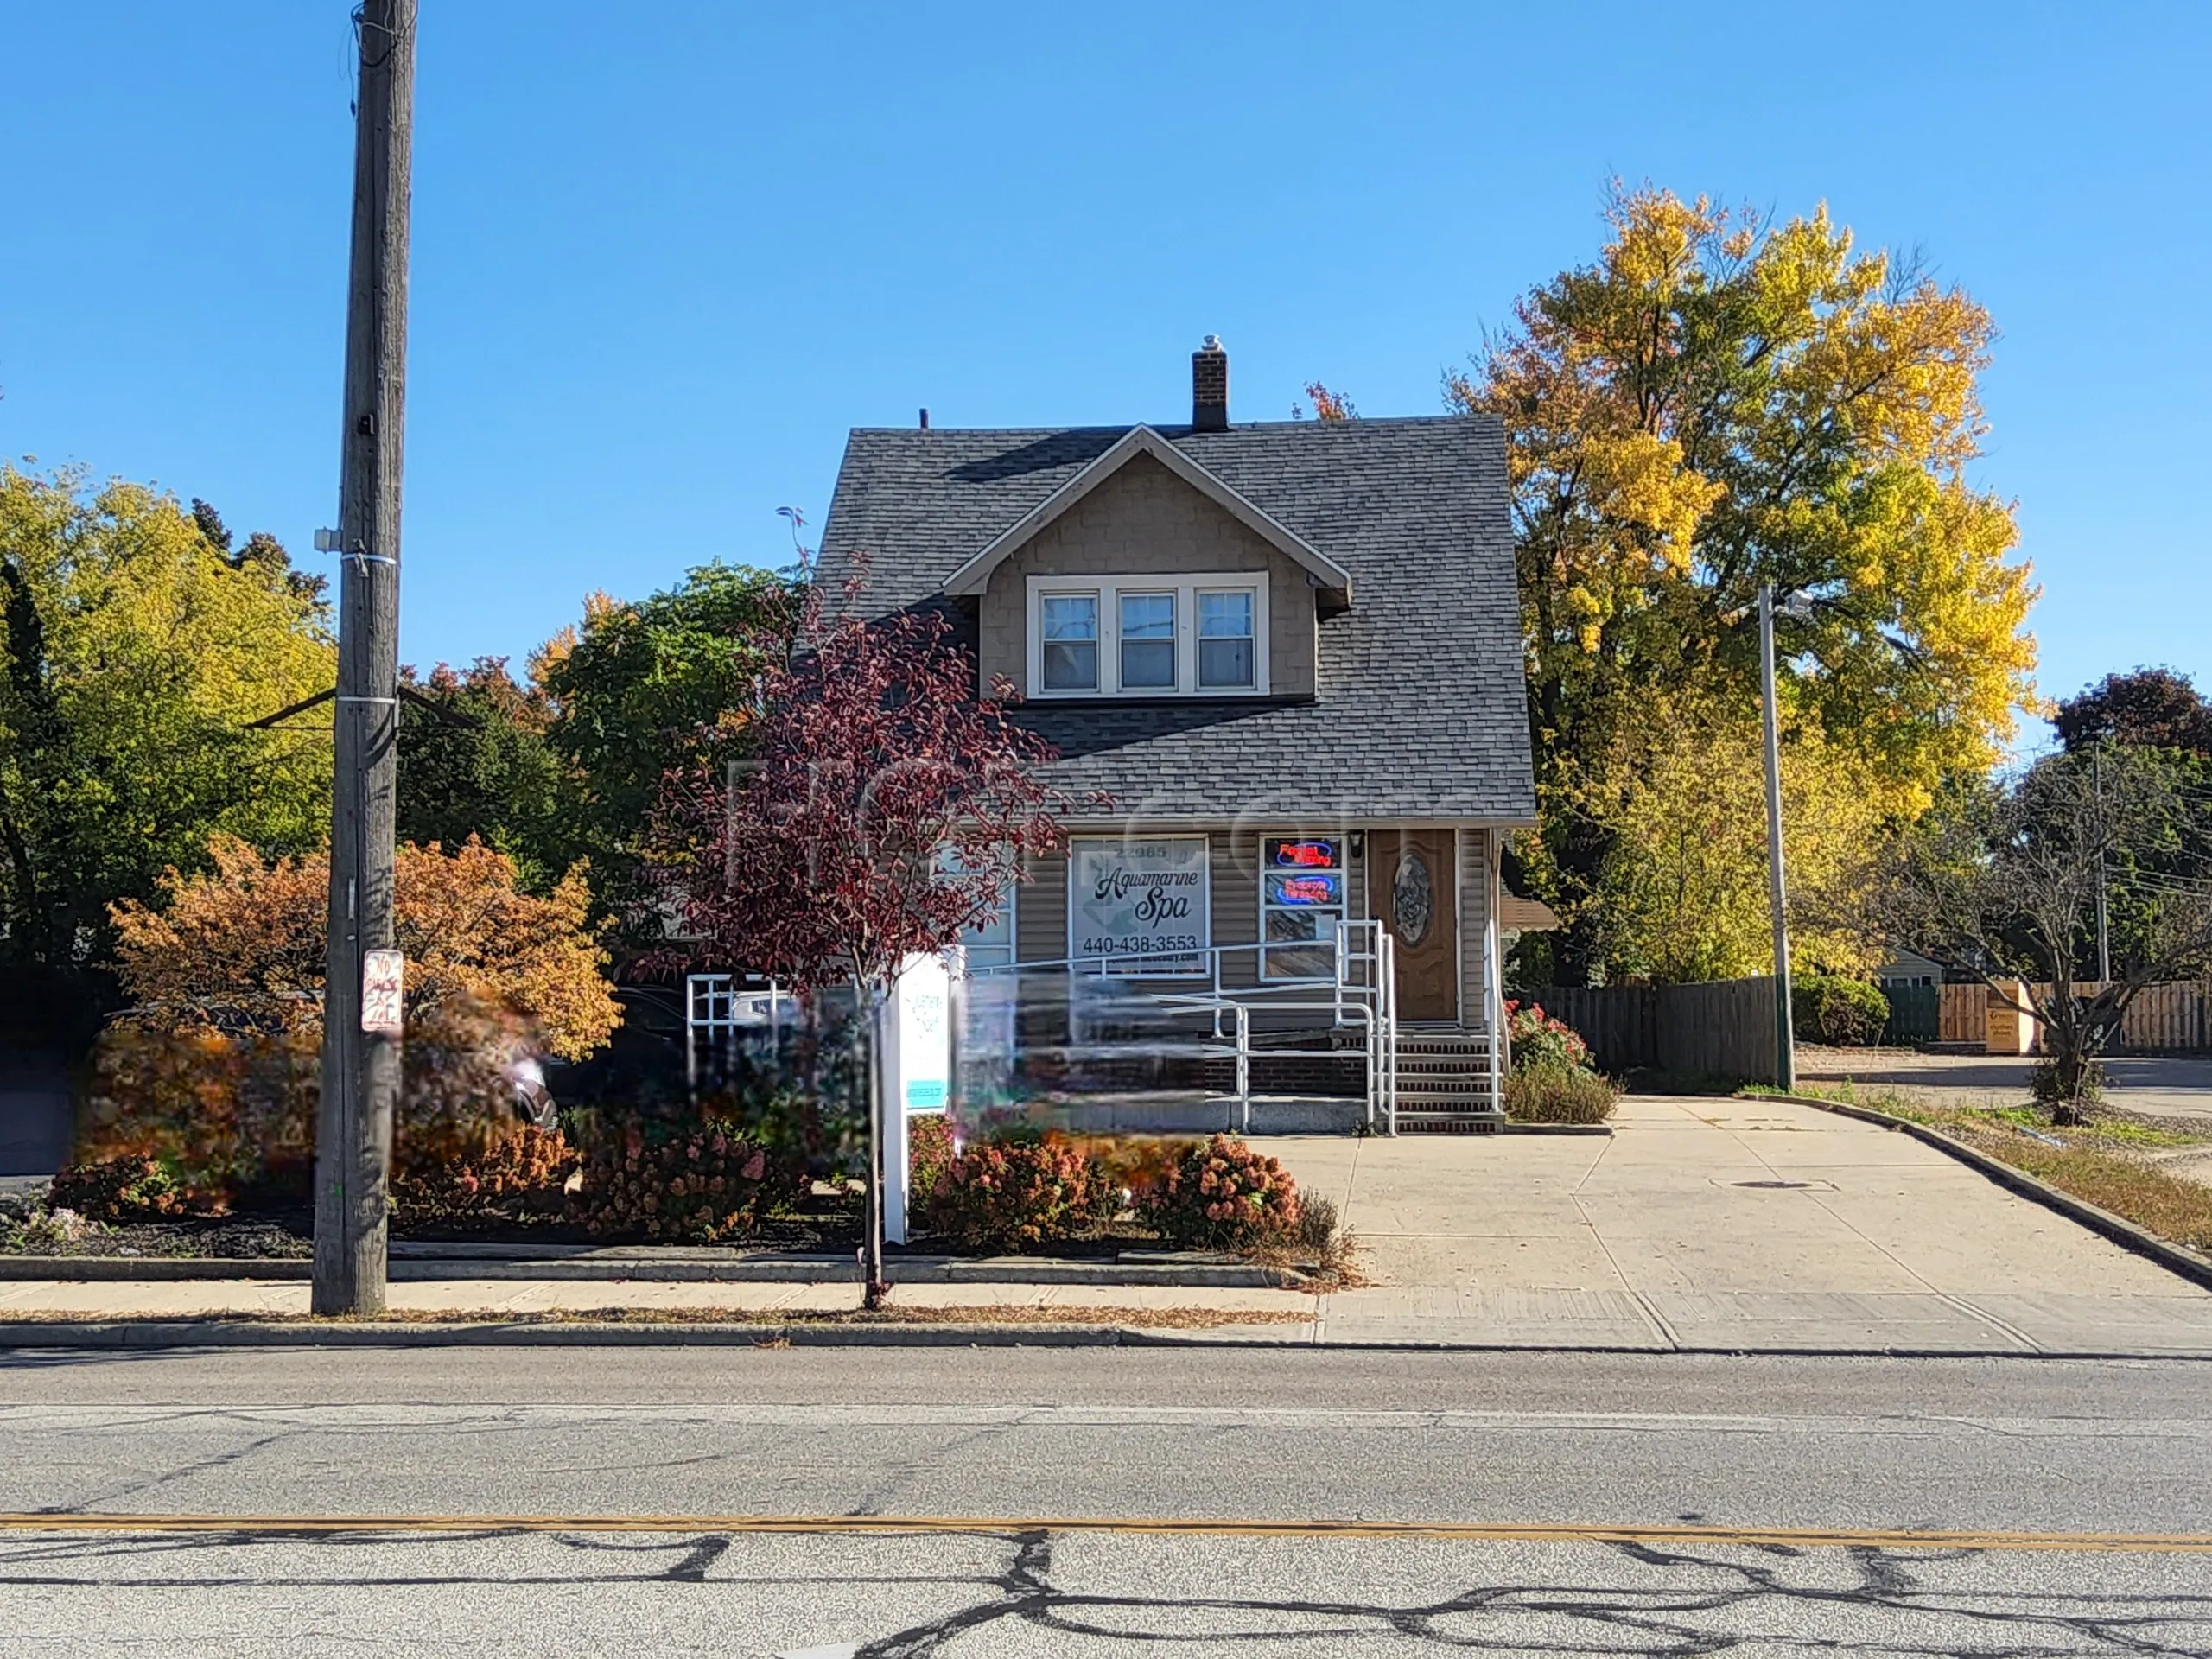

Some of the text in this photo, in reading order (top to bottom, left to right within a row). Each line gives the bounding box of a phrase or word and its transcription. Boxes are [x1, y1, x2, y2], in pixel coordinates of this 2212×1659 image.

[1095, 867, 1198, 899] Aquamarine
[1135, 887, 1192, 929] Spa
[1083, 936, 1197, 953] 440-438-3553
